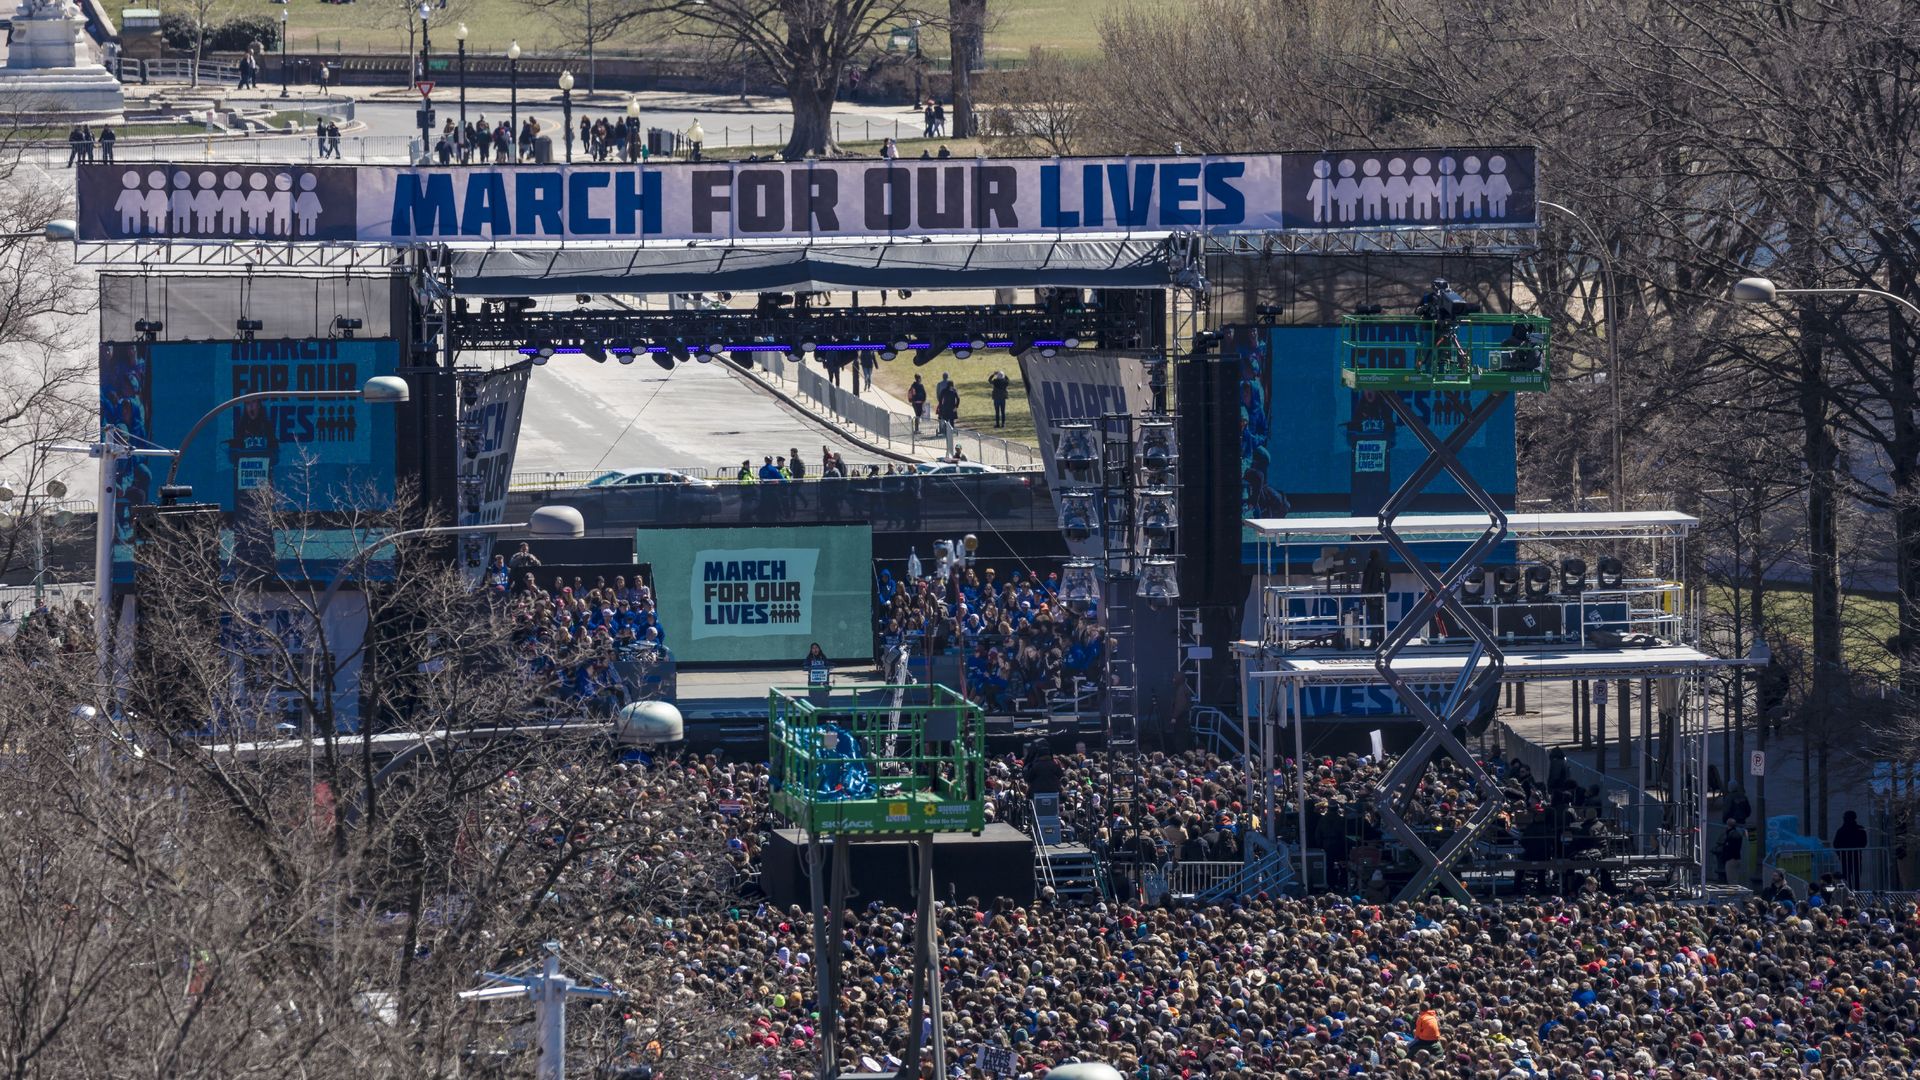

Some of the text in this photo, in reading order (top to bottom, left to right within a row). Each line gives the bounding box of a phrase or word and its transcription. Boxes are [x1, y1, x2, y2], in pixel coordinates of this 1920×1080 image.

[391, 161, 1246, 236] MARCH FOR OUR LIVES
[232, 363, 357, 400] FOR OUR
[704, 560, 787, 581] MARCH
[704, 582, 801, 603] FOR OUR
[704, 604, 769, 625] LIVES
